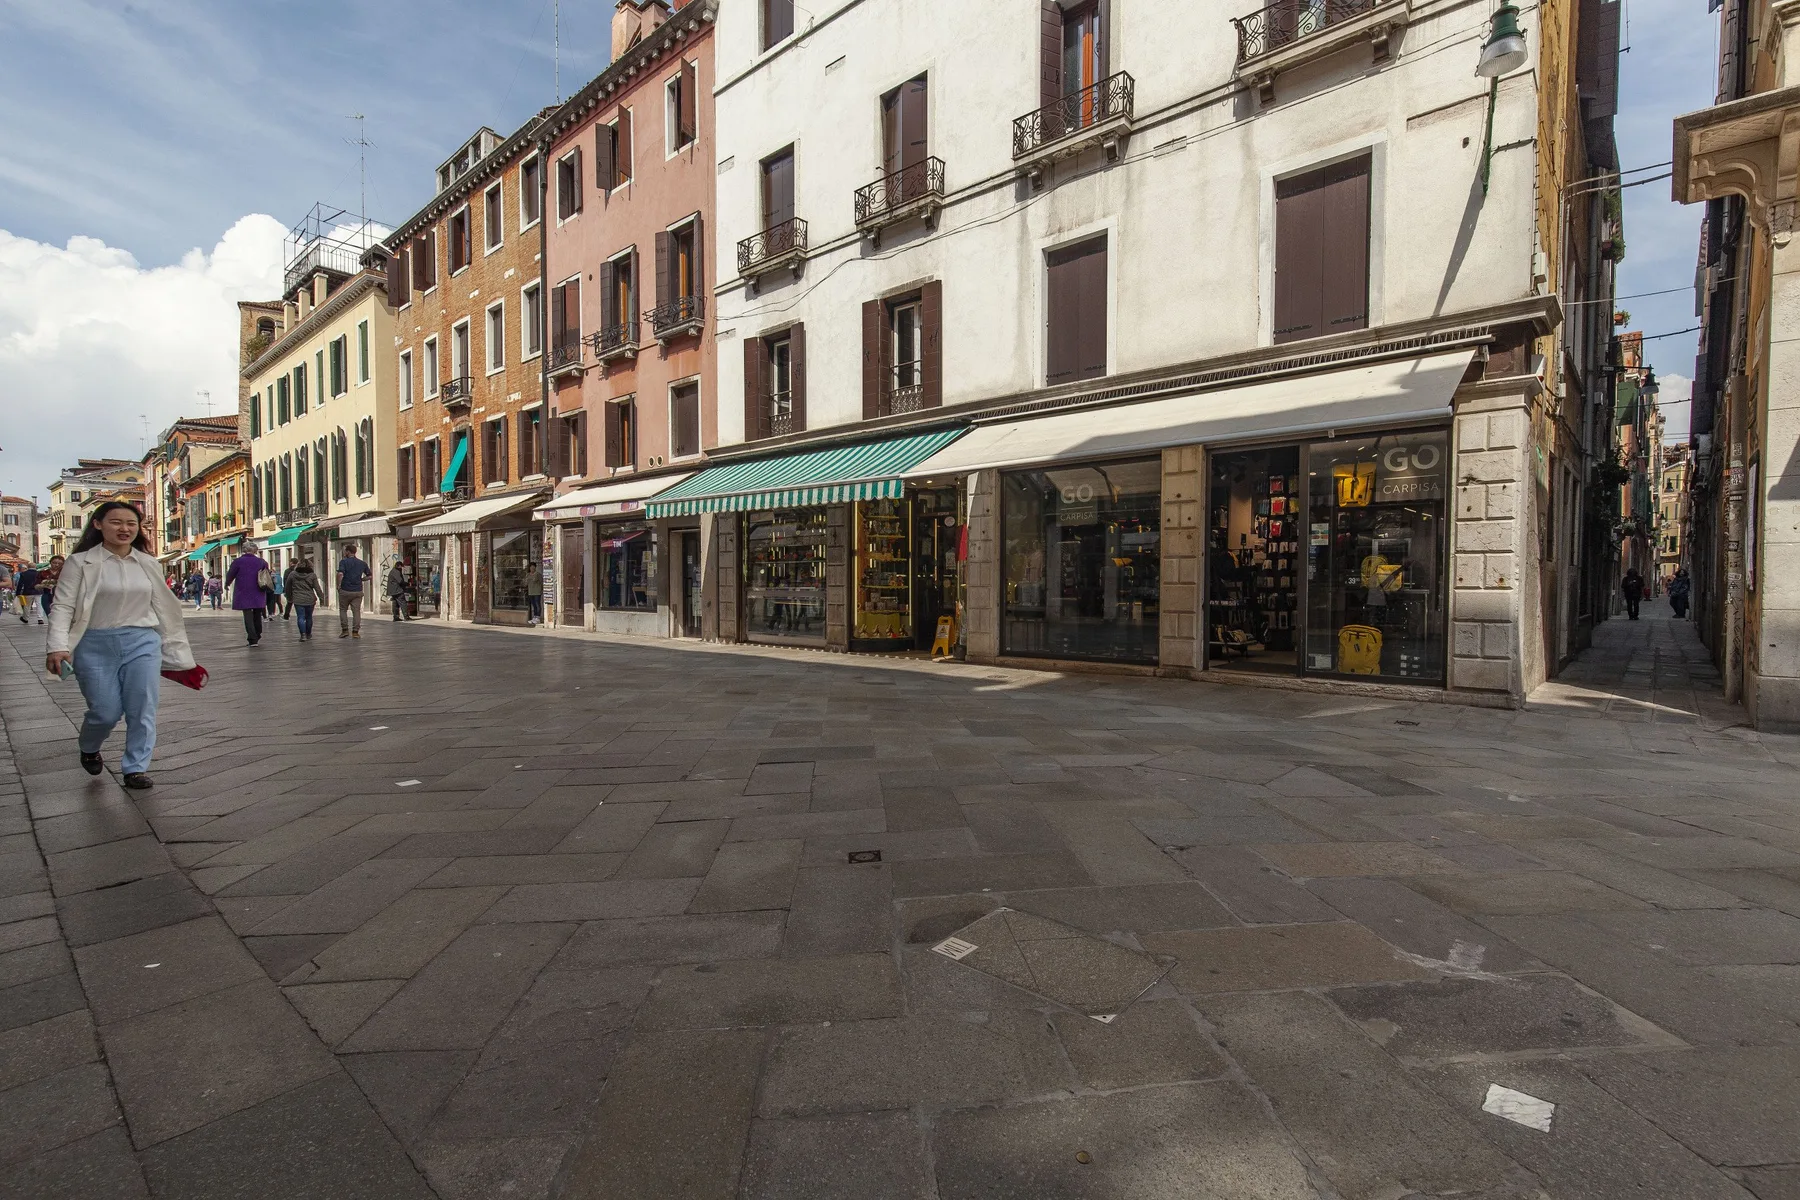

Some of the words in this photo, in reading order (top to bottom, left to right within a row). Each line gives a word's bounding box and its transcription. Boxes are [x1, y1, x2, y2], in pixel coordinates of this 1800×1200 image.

[1384, 445, 1440, 472] GO
[1061, 483, 1094, 504] GO
[1383, 483, 1439, 495] CARPISA
[1060, 511, 1094, 521] CARPISA
